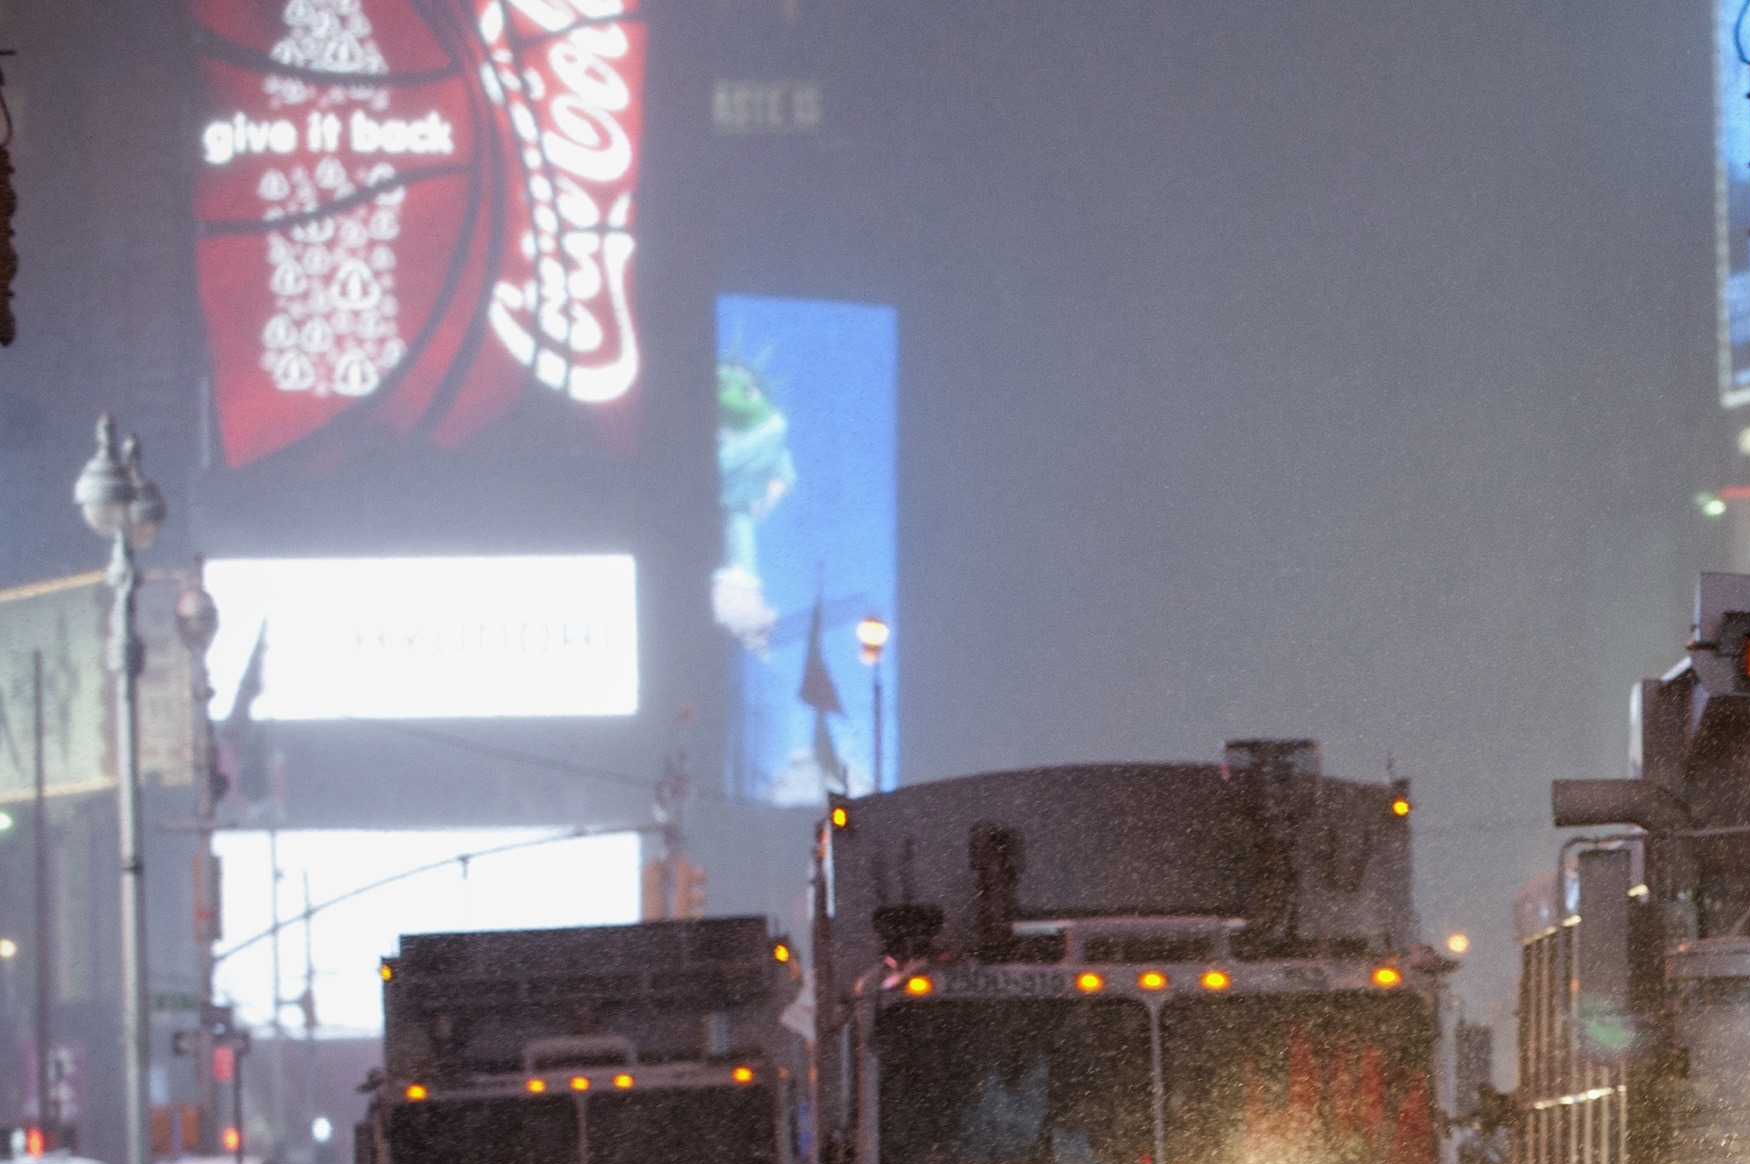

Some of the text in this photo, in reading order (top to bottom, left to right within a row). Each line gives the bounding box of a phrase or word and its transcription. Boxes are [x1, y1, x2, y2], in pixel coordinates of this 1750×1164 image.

[202, 108, 454, 164] give it back
